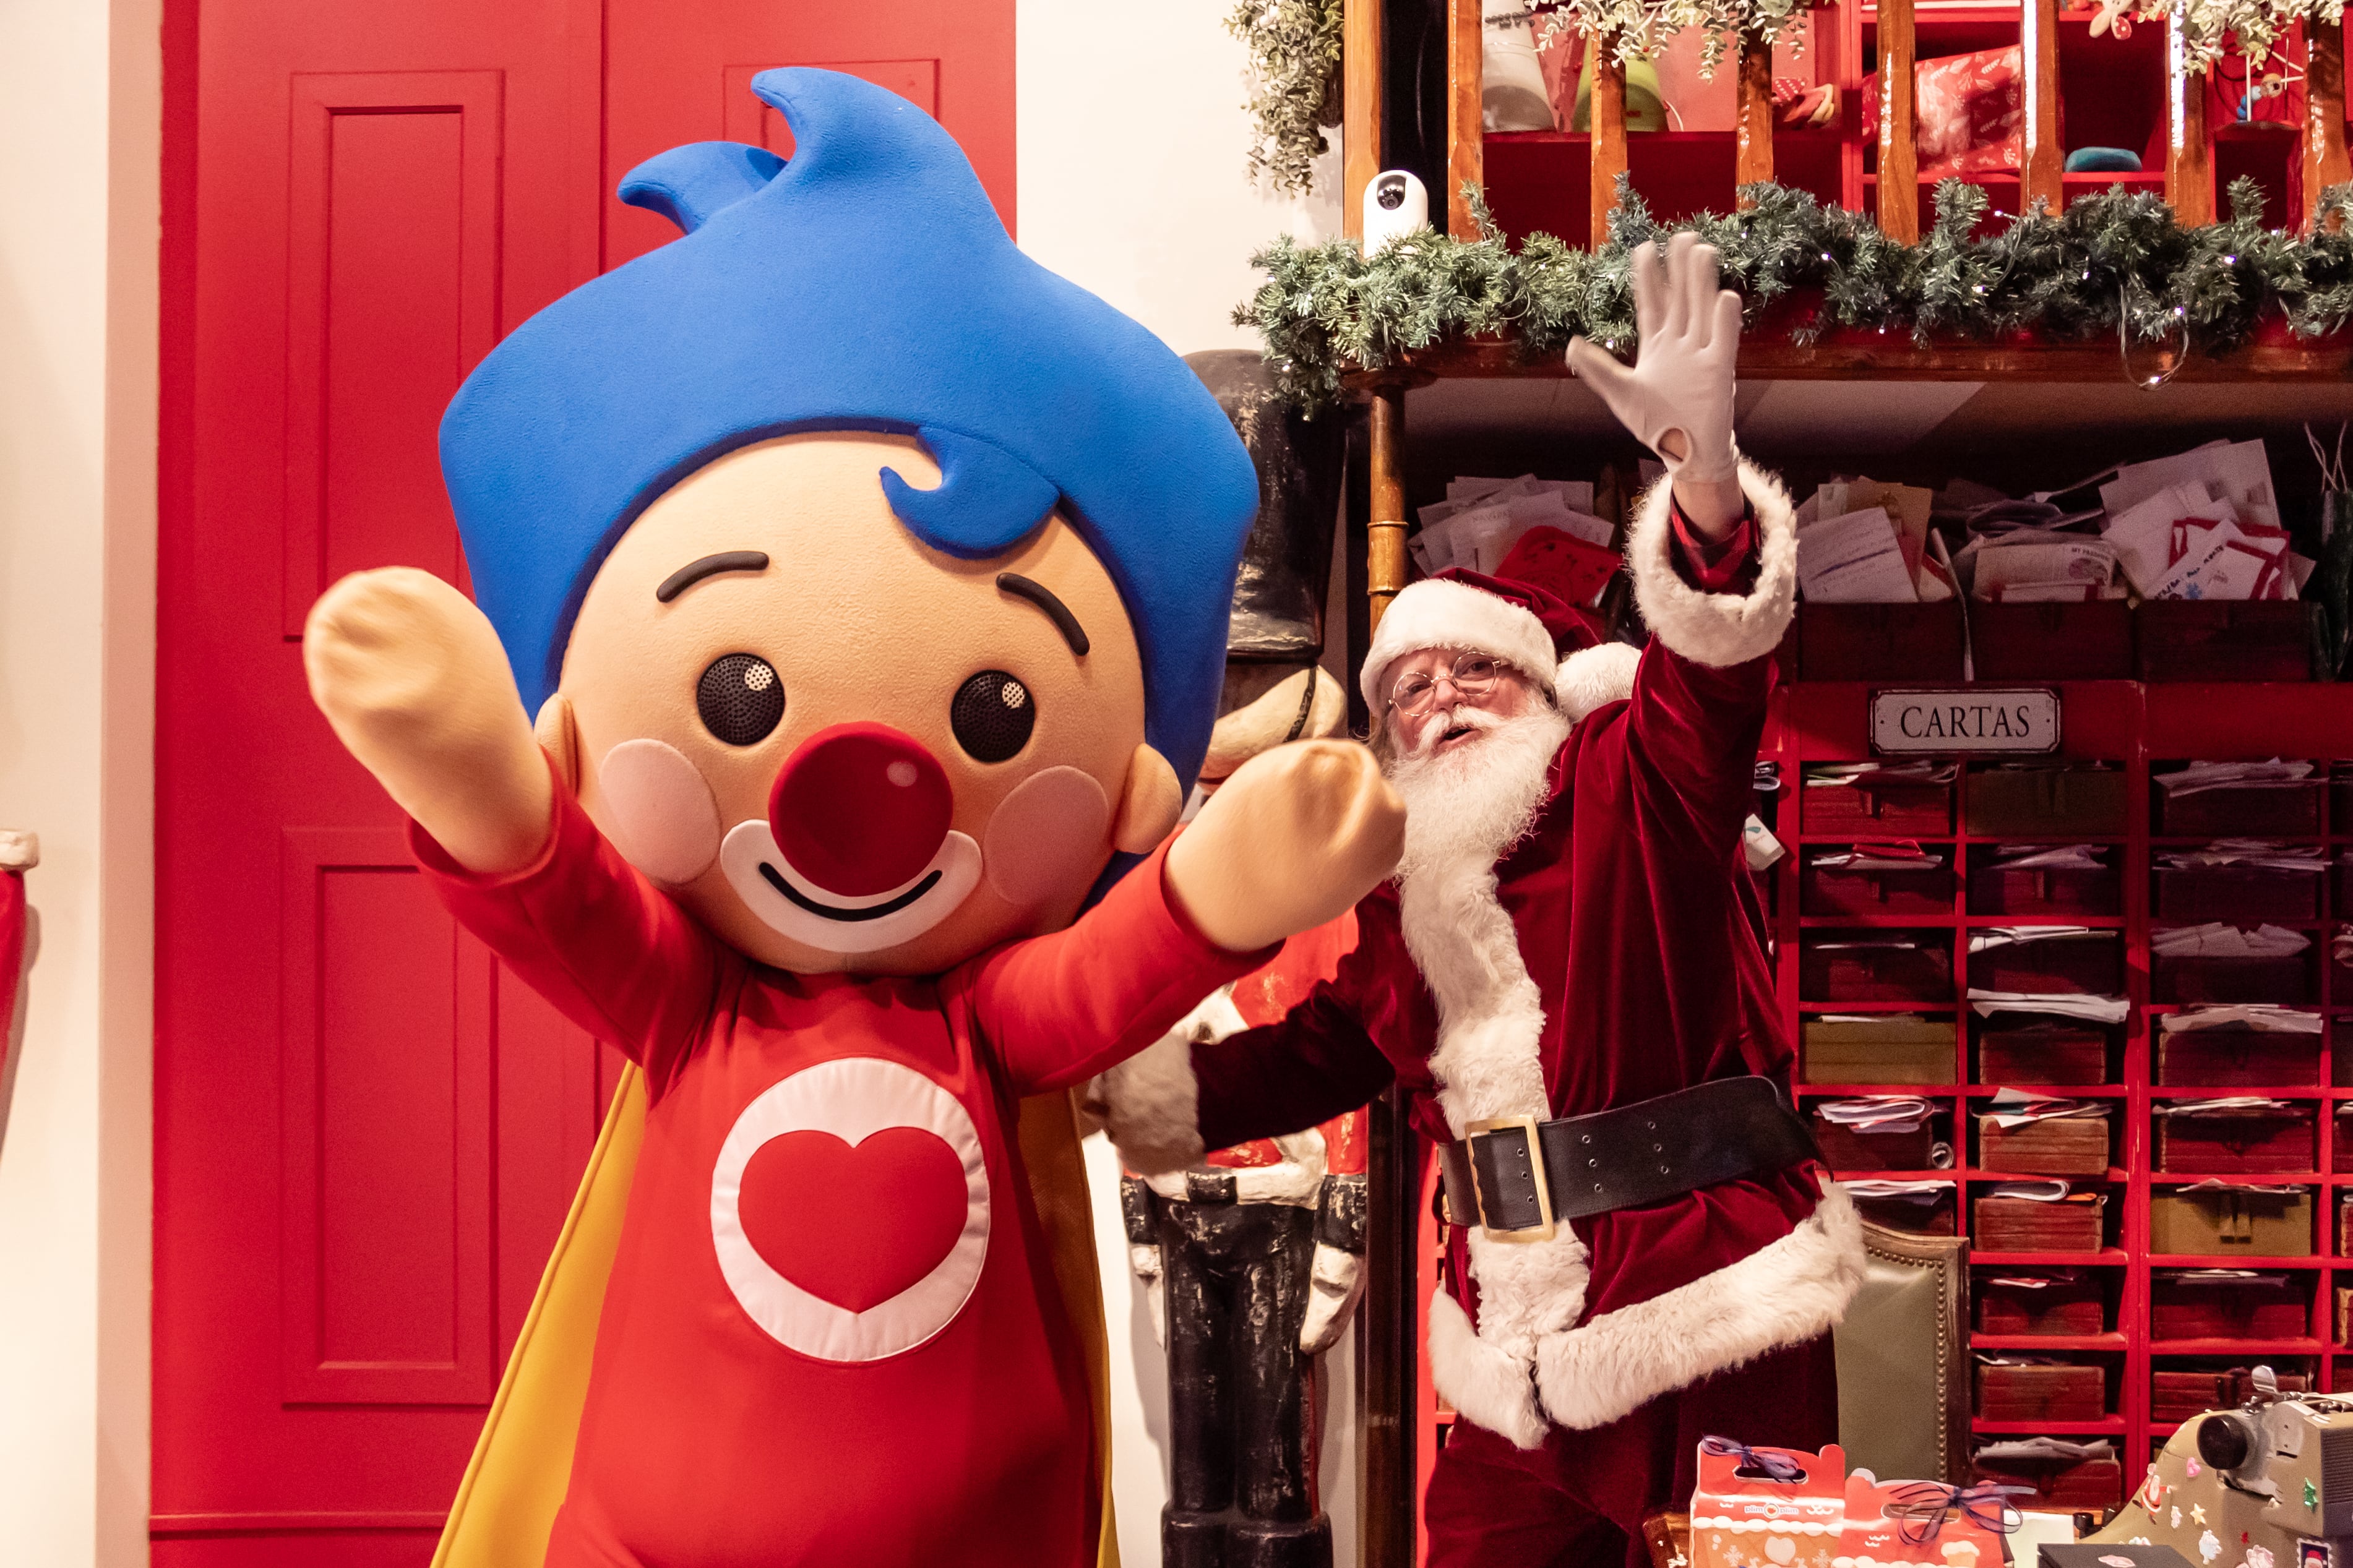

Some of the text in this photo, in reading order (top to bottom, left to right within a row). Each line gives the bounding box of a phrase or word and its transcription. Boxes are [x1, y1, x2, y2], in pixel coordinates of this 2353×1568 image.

[1900, 705, 2030, 738] CARTAS
[1745, 1505, 1798, 1515] plim plim
